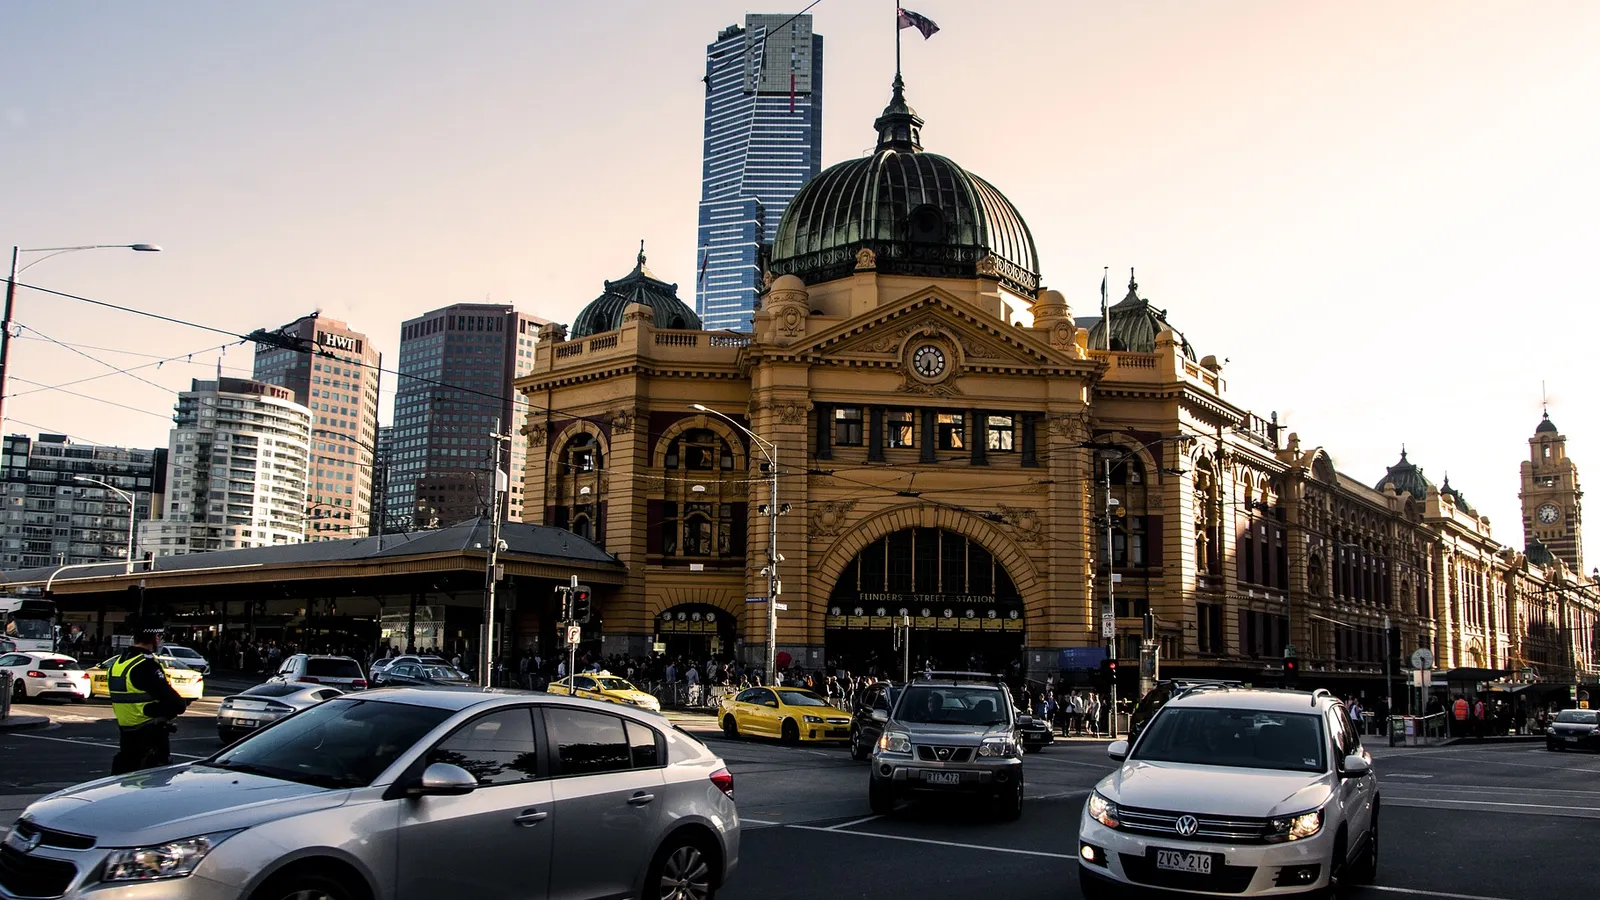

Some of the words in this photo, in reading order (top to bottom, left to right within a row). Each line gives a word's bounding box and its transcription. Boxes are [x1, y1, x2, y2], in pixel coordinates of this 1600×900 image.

[326, 333, 354, 350] HWT
[270, 387, 289, 401] WEST
[860, 593, 903, 601] FLINDERS
[913, 594, 946, 602] STREET
[956, 595, 996, 603] STATION
[1159, 851, 1180, 866] ZVS
[1189, 855, 1210, 869] 216
